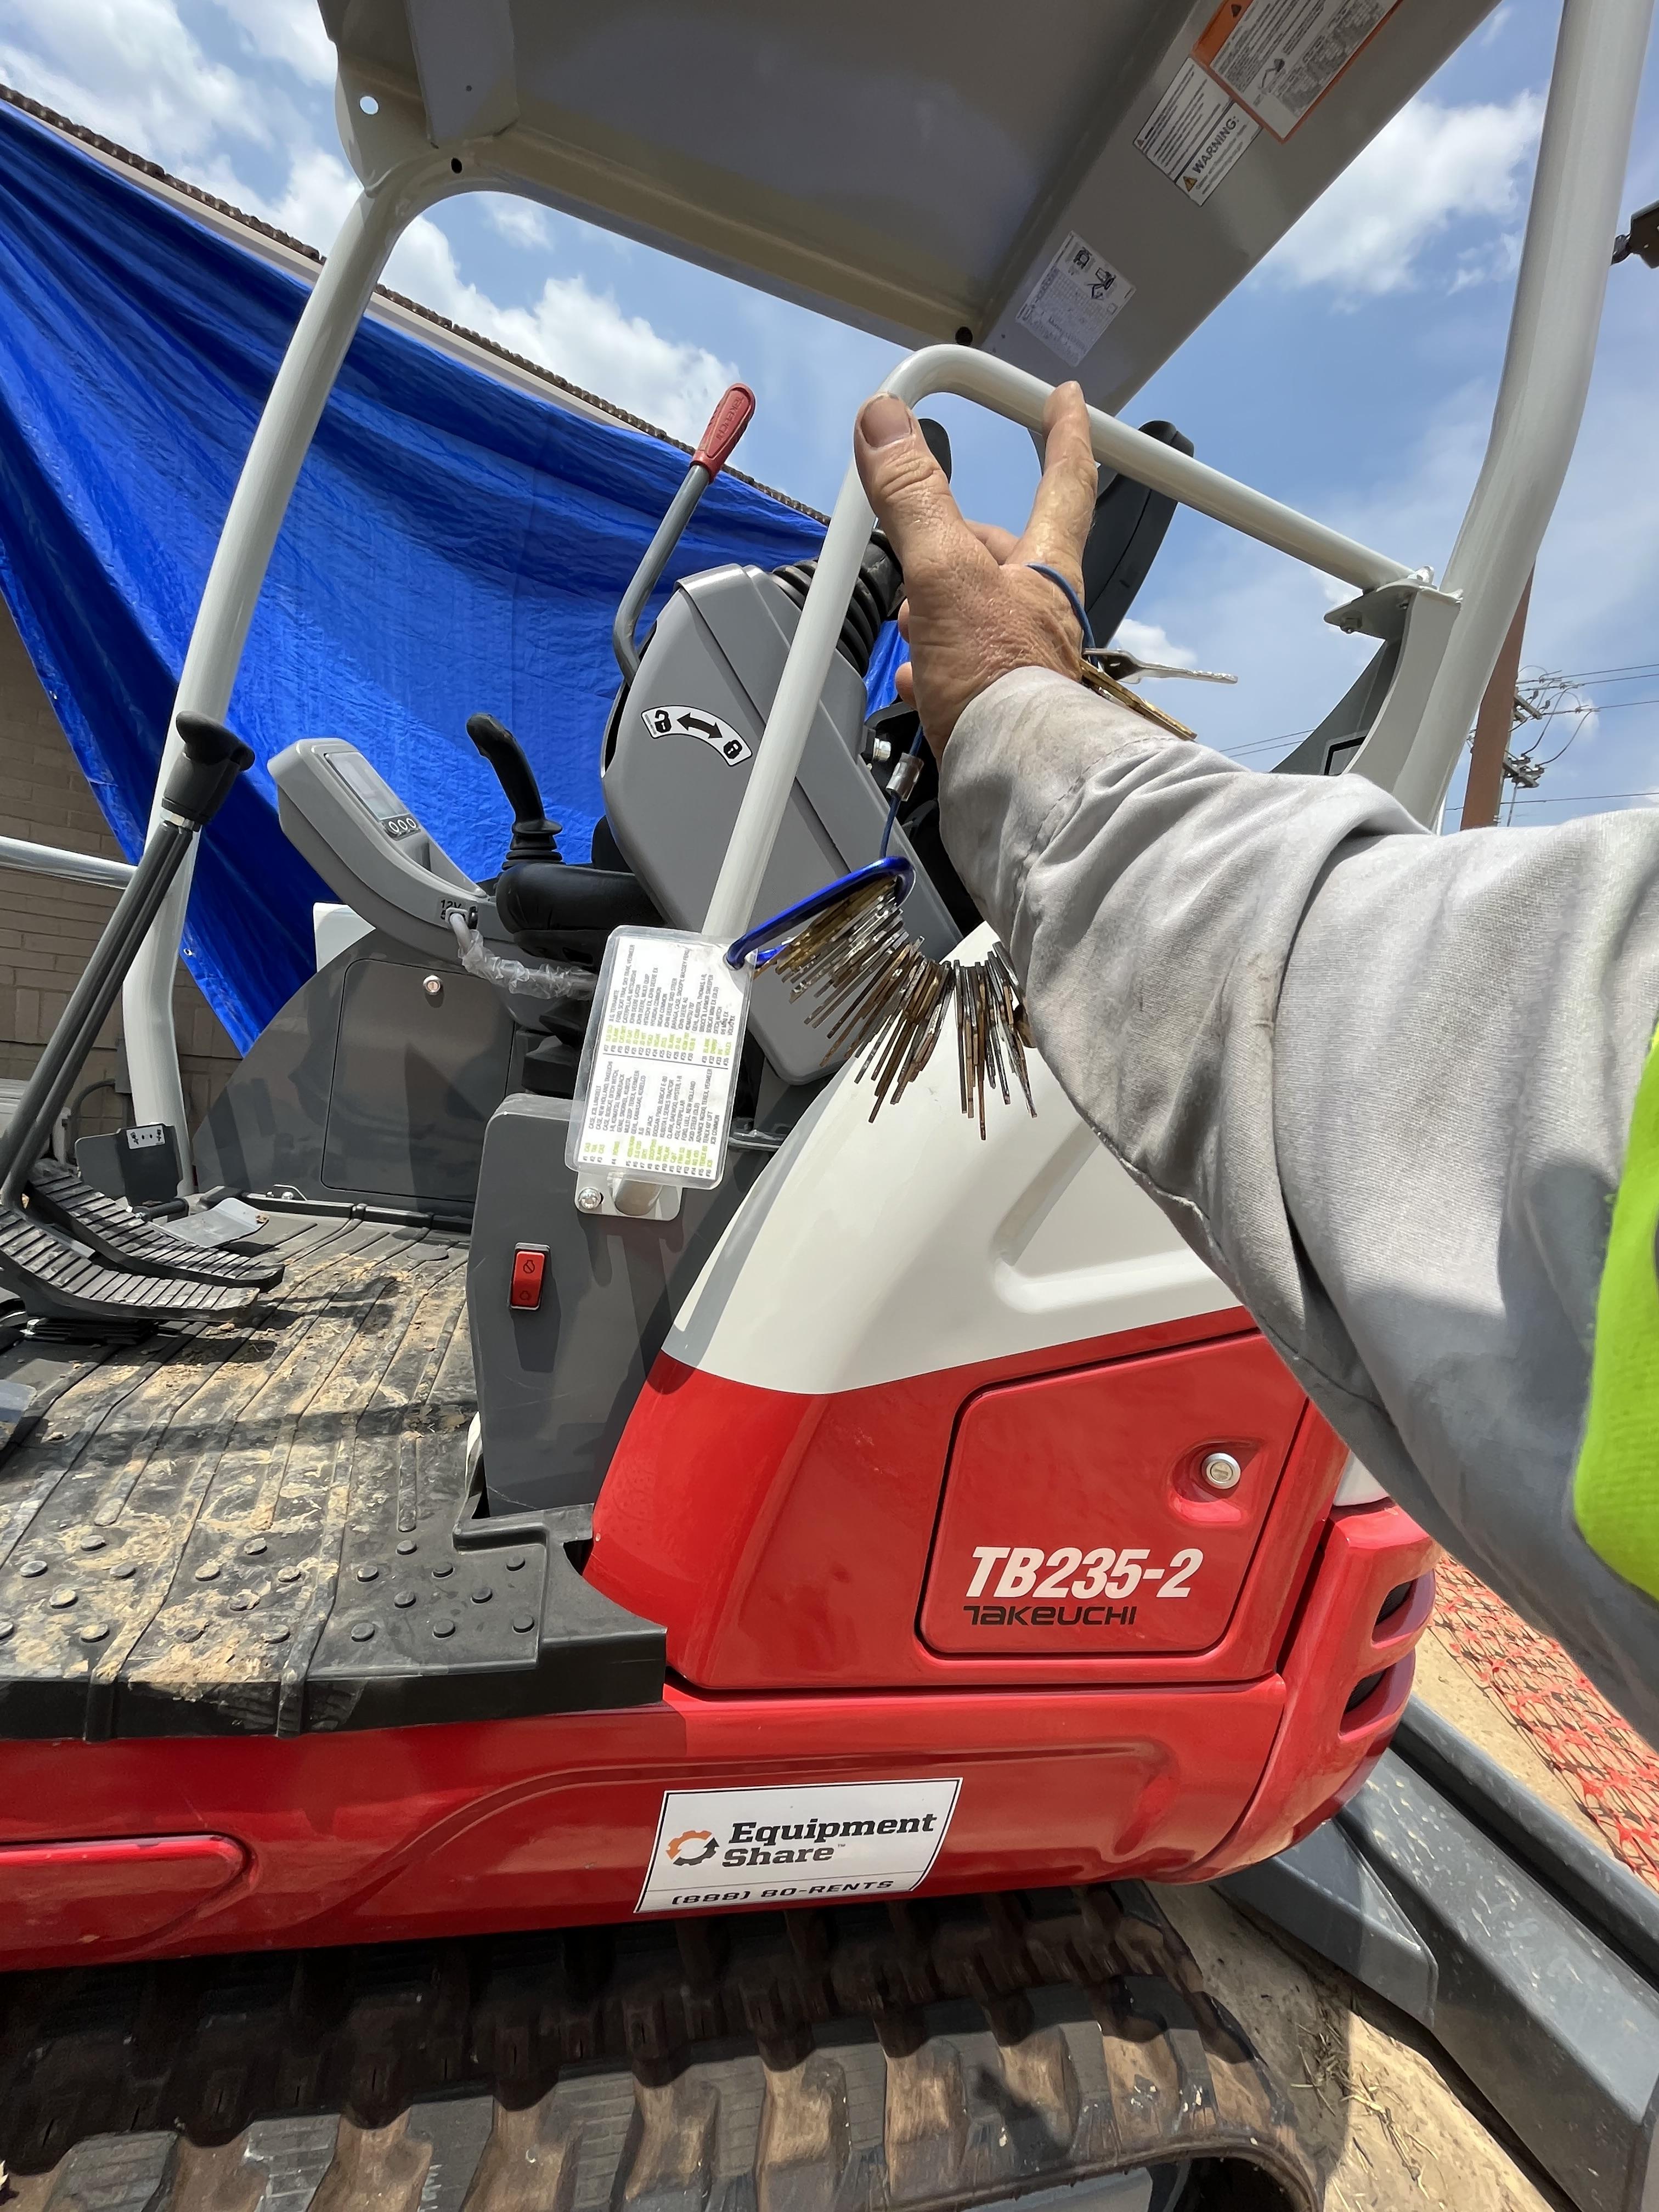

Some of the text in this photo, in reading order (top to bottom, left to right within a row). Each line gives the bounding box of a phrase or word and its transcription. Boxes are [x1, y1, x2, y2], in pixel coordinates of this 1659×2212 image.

[1192, 116, 1240, 173] WARNING:
[441, 899, 462, 909] 12V
[966, 1546, 1204, 1599] TB235-2
[728, 1813, 937, 1846] Equipment
[721, 1846, 834, 1867] Share
[672, 1880, 895, 1905] (888) 80-RENTS
